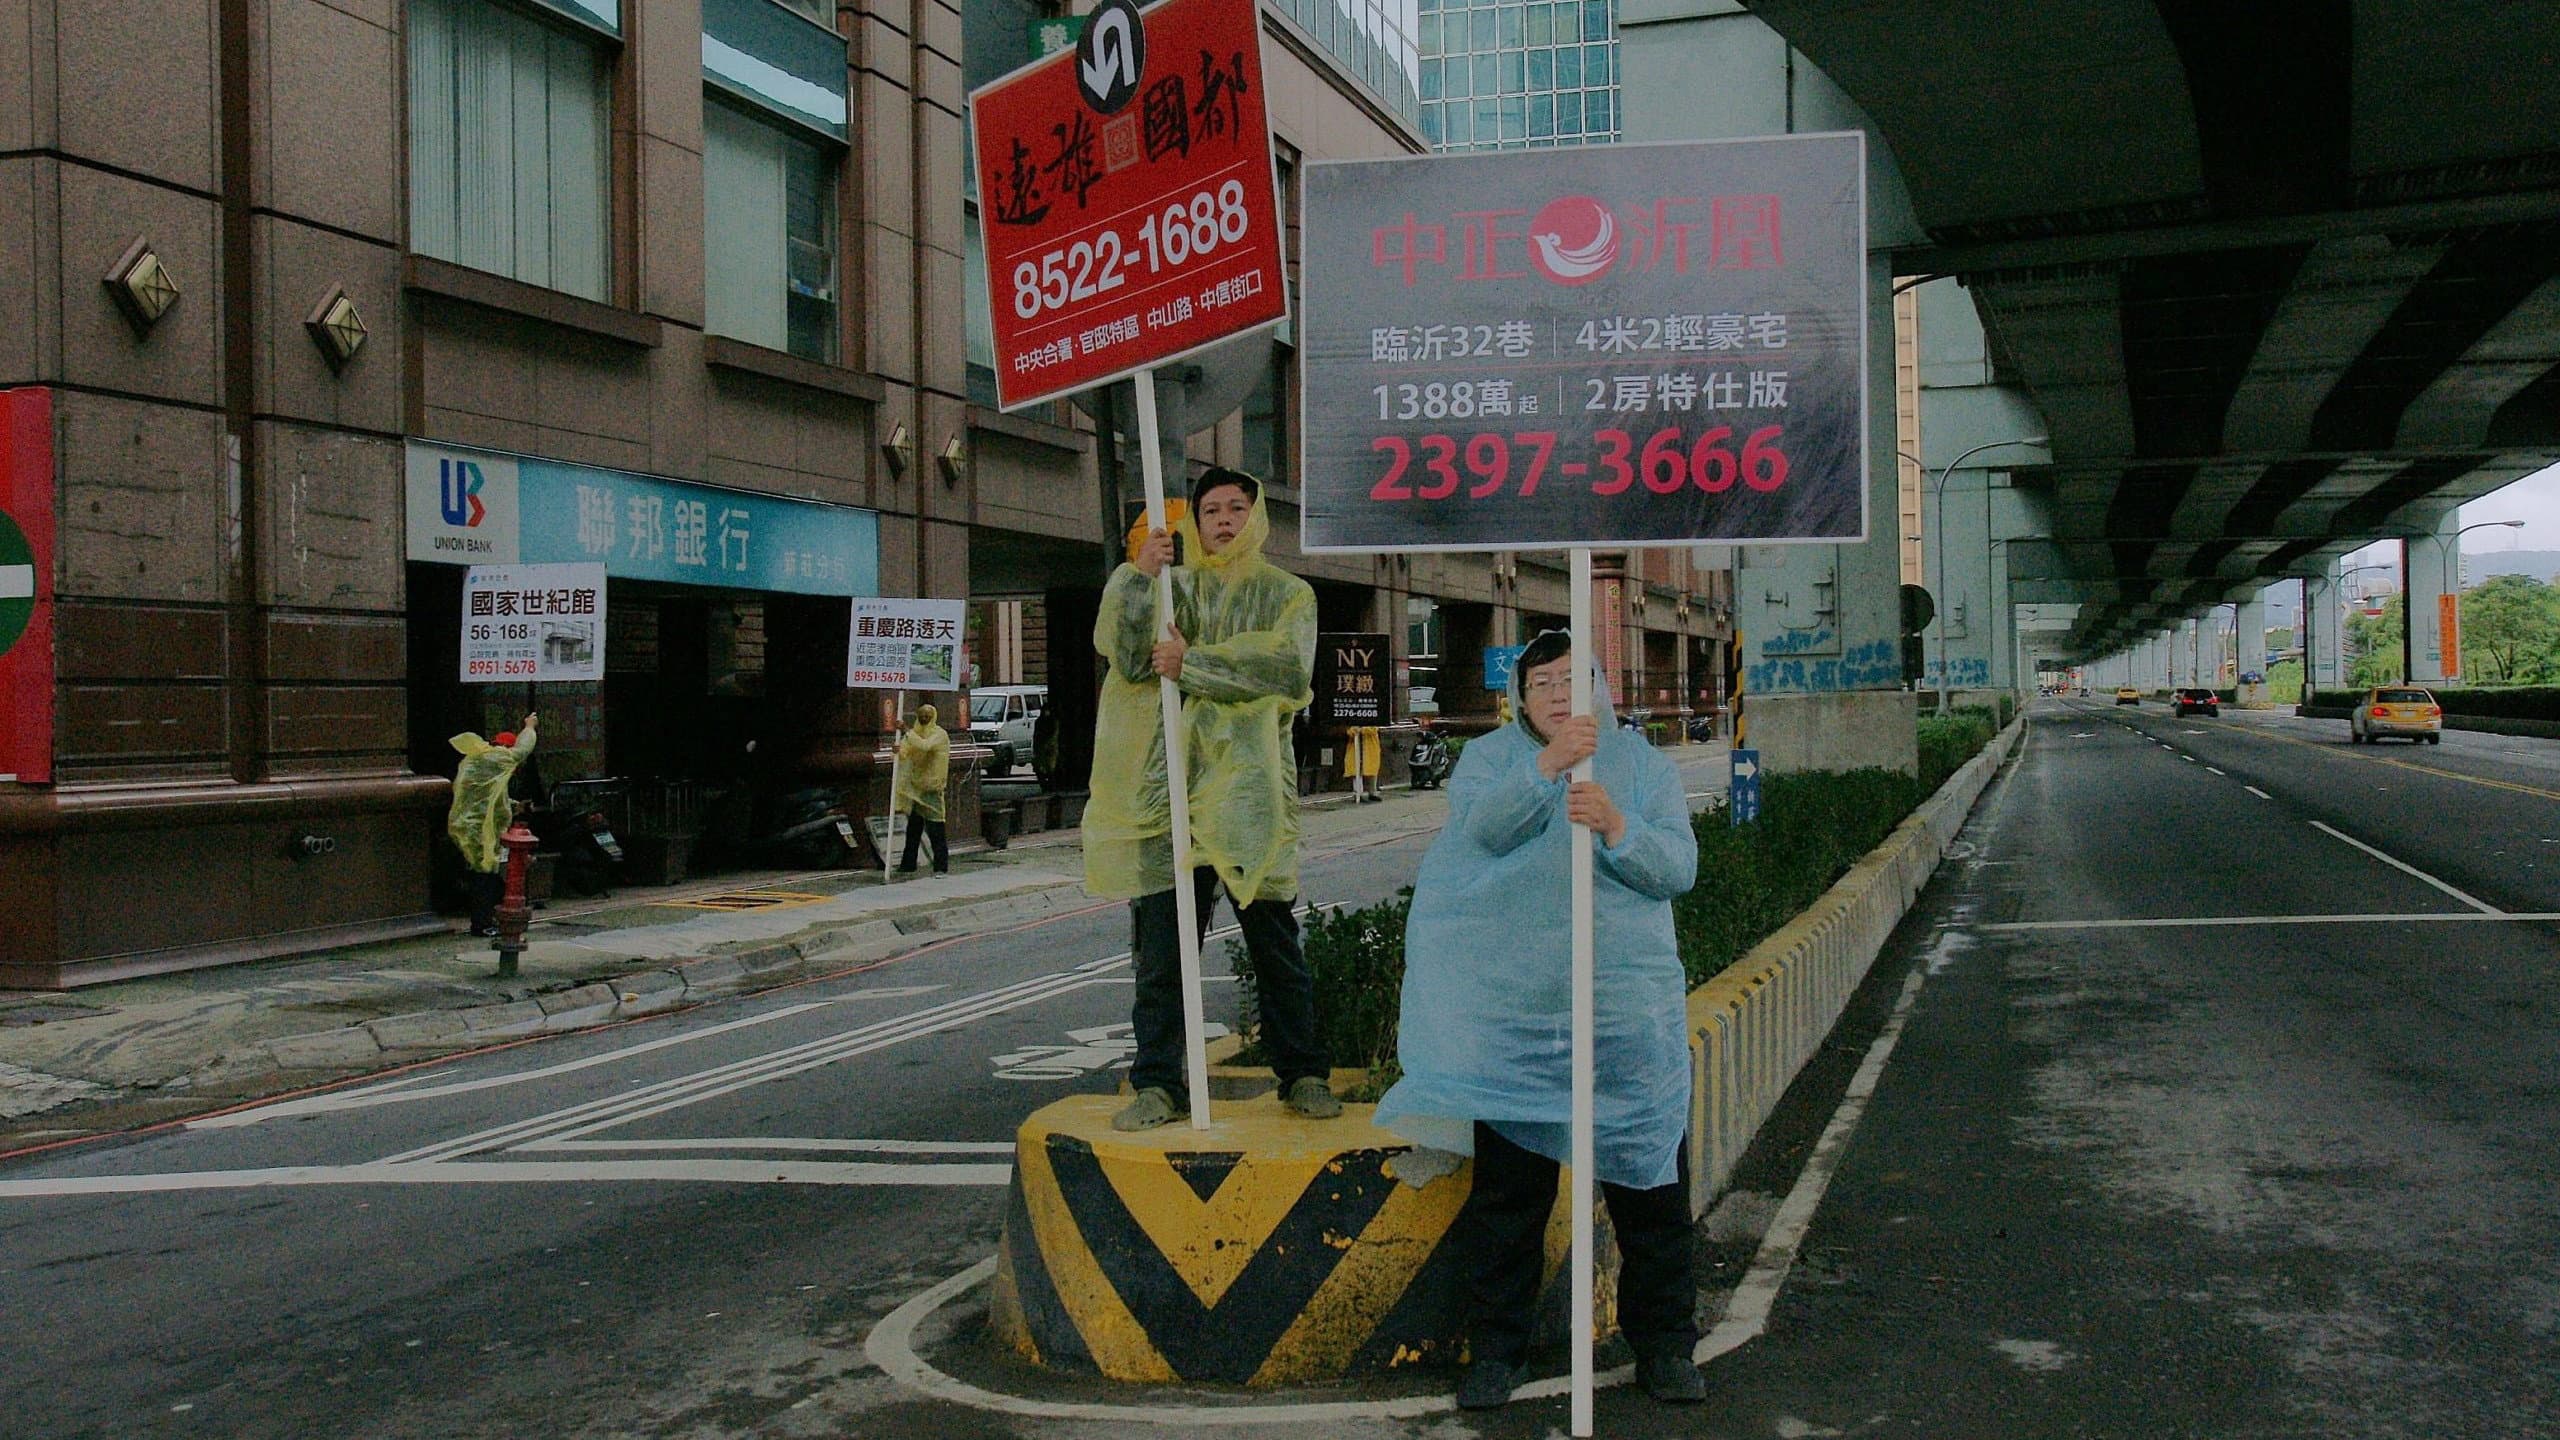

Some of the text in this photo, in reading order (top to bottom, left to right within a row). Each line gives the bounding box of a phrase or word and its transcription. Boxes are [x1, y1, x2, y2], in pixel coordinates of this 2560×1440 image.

[1014, 179, 1249, 319] 8522-1688
[1371, 311, 1788, 362] 臨沂32巷 4米2輕豪宅
[1585, 371, 1788, 412] 2房特仕版
[1370, 423, 1789, 501] 2397-3666
[434, 536, 493, 553] UNION BANK
[576, 484, 750, 572] 聯邦銀行
[471, 588, 596, 617] 國家世紀館
[857, 616, 955, 640] 重慶路透天
[1336, 648, 1375, 668] NY
